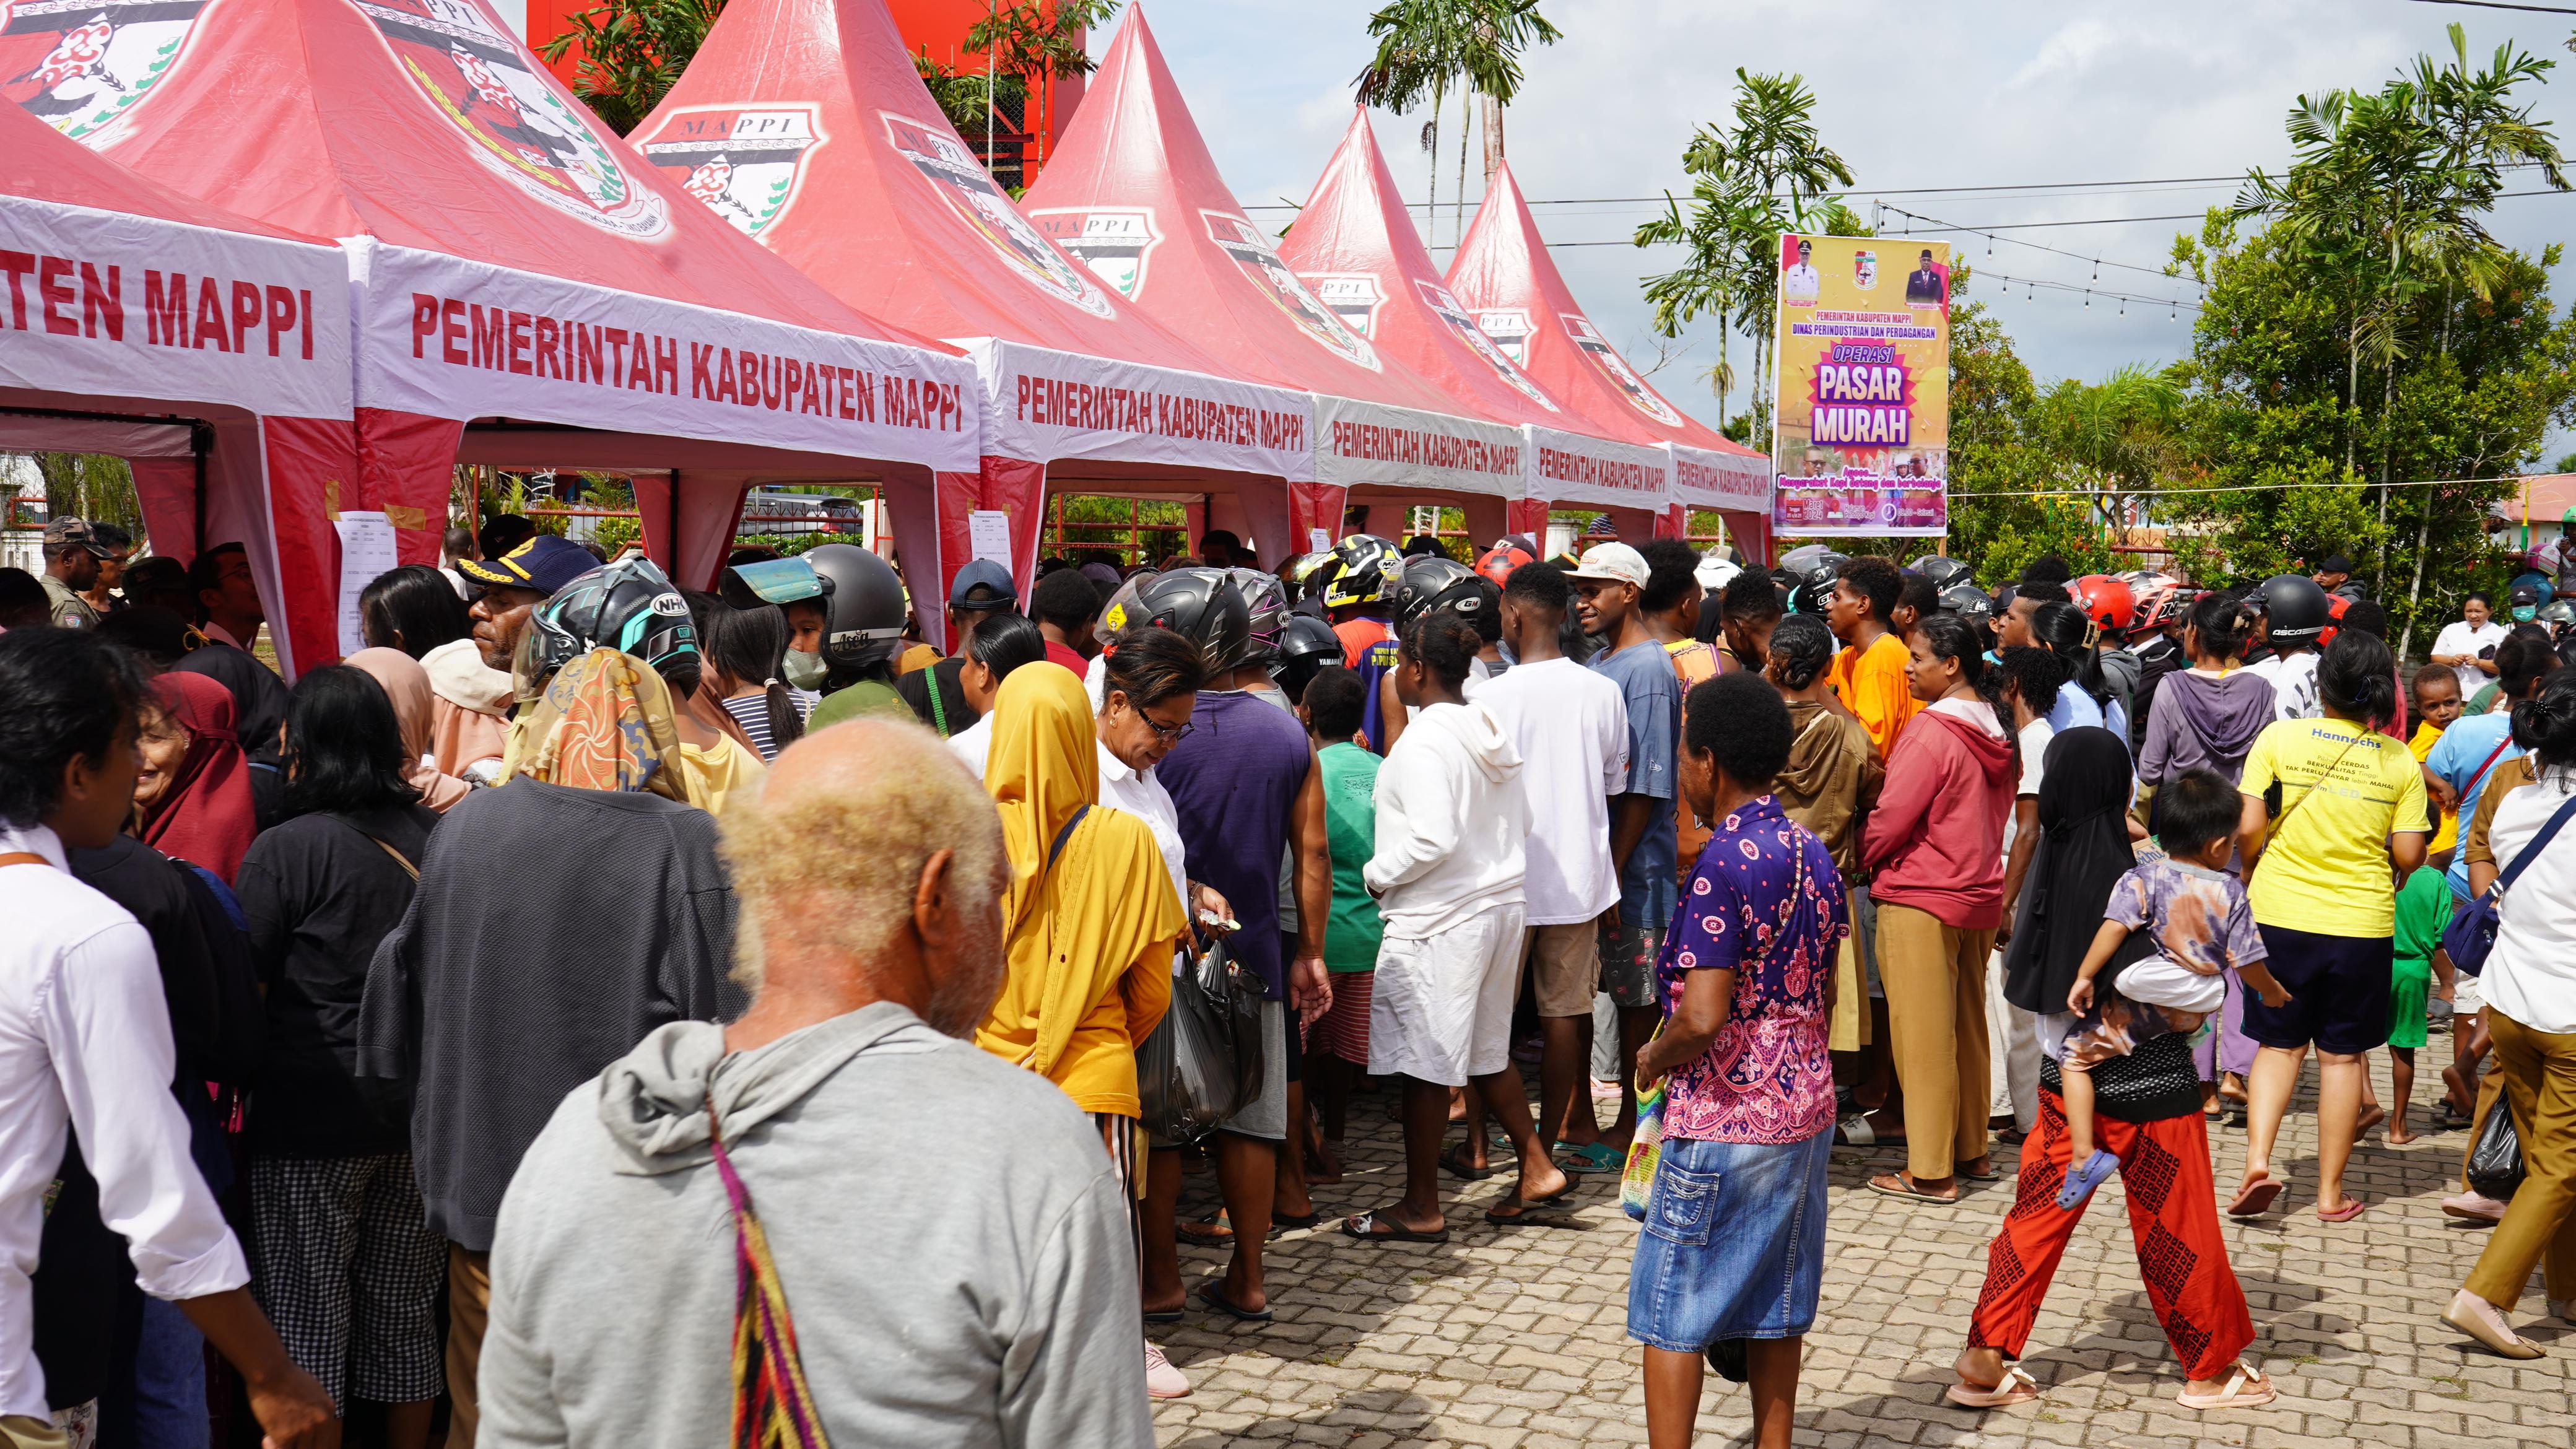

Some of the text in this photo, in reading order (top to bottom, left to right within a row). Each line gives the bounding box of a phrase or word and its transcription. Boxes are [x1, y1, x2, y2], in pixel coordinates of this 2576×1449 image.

[395, 0, 479, 26] PPI
[679, 118, 793, 136] MAPPI
[902, 130, 964, 163] MAPPI
[1043, 219, 1133, 233] MAPPI
[1216, 222, 1260, 243] MAPPI
[0, 251, 313, 360] TEN MAPPI
[1816, 311, 1912, 325] PEMERINTAH KABUPATEN MAPPI
[1793, 323, 1936, 339] DINAS PERINDUSTRIAN DAN PERDAGANGAN
[412, 292, 962, 433] PEMERINTAH KABUPATEN MAPPI
[1832, 344, 1895, 363] OPERASI
[1819, 365, 1902, 402] PASAR
[1017, 374, 1304, 452] PEMERINTAH KABUPATEN MAPPI
[1814, 407, 1907, 443] MURAH
[1333, 420, 1520, 476] PEMERINTAH KABUPATEN MAPPI
[1539, 446, 1666, 494] PEMERINTAH KABUPATEN MAPPI
[1677, 459, 1769, 497] PEMERINTAH KABUPATEN MAPPI
[1779, 477, 1941, 490] Masyarakat Kepi datang dan berbelanja
[1803, 498, 1823, 509] Maret
[1803, 510, 1823, 520] 2024
[1844, 511, 1865, 520] Pendopo
[2312, 728, 2382, 749] Hannochs
[2307, 760, 2378, 779] BERKUALITAS Tinggi
[2317, 755, 2370, 769] Piliha CERDAS
[2301, 767, 2324, 776] PERLU
[2325, 772, 2349, 781] BAYAR
[2369, 781, 2395, 790] MAHAL
